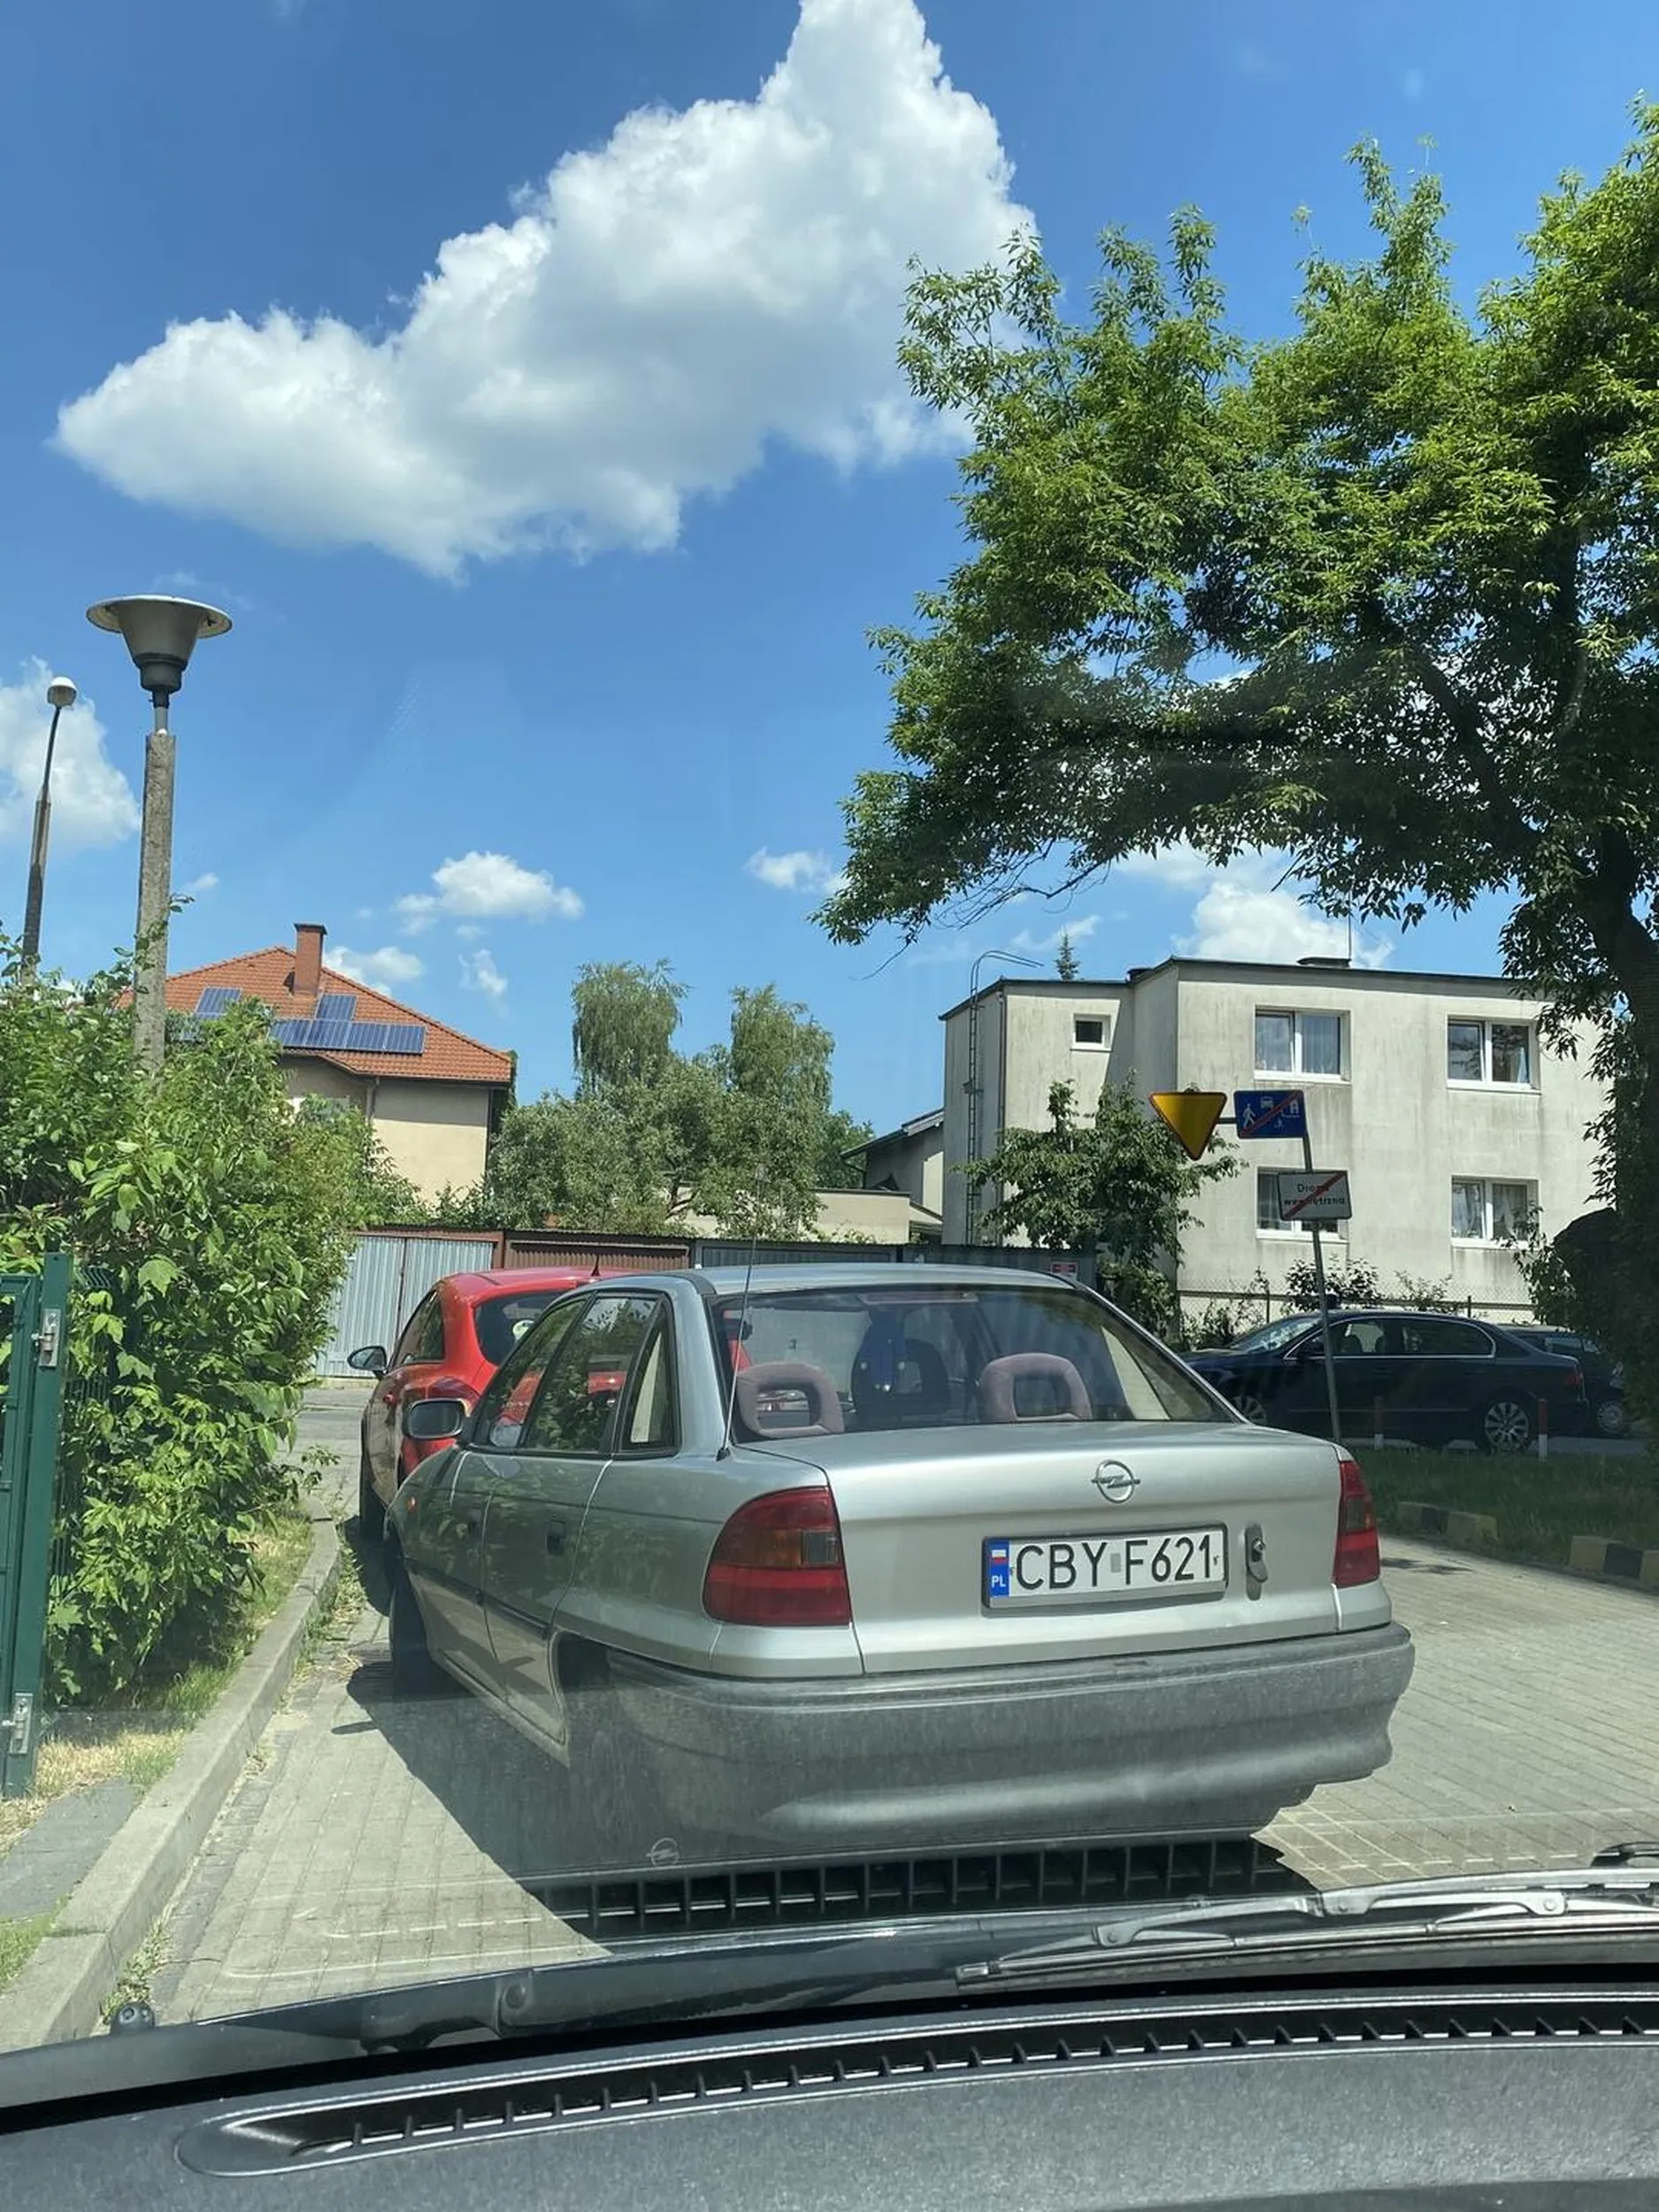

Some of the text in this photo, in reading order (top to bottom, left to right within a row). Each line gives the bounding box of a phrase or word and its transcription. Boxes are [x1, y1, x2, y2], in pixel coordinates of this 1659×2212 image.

[1297, 1183, 1329, 1194] Dro
[1016, 1534, 1211, 1590] CBY F621
[991, 1575, 1007, 1588] PL
